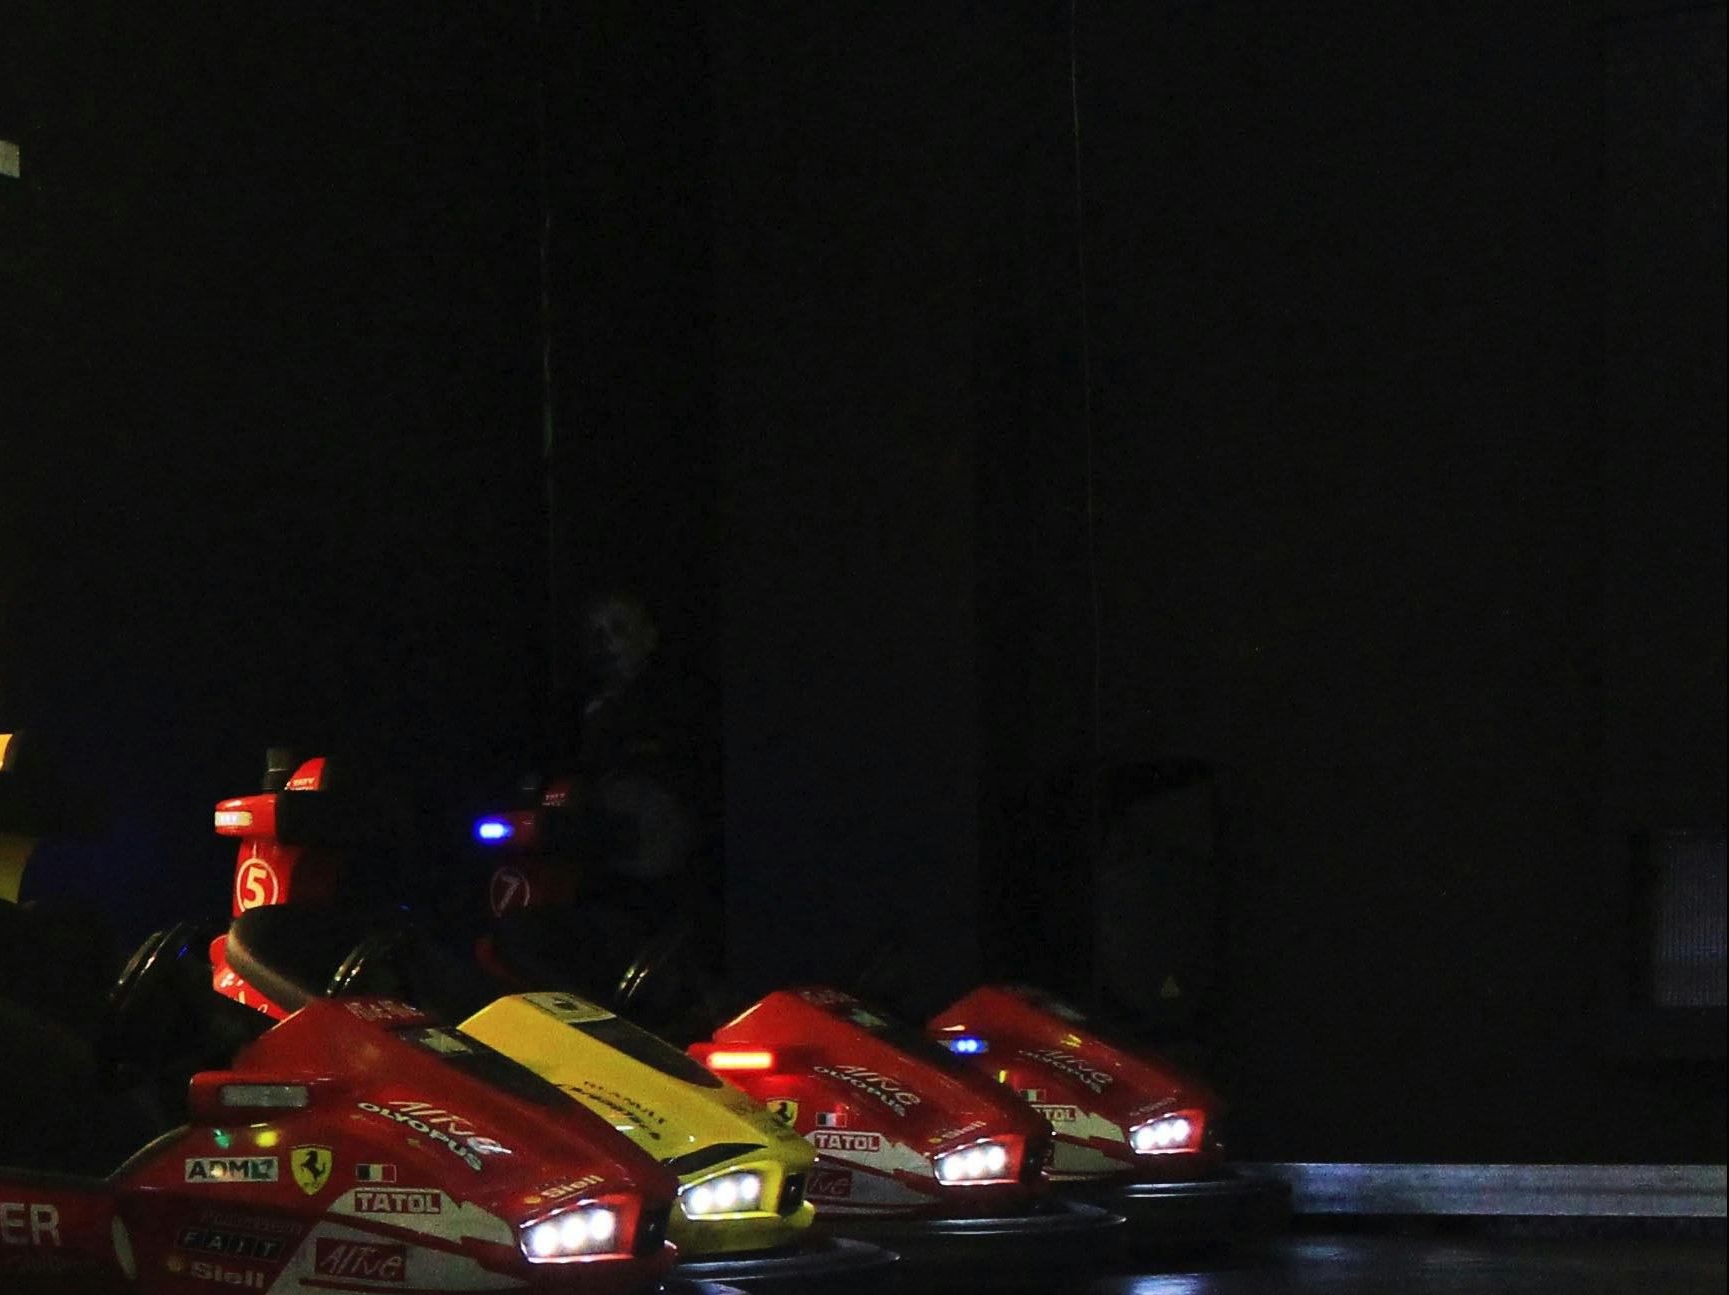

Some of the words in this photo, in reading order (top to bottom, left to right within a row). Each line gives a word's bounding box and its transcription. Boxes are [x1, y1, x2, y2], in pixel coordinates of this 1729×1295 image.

[243, 867, 267, 909] 5
[1040, 1109, 1077, 1121] TOL
[357, 1101, 484, 1171] OLYOPUS
[815, 1134, 880, 1151] TATOL
[358, 1191, 440, 1213] TATOL
